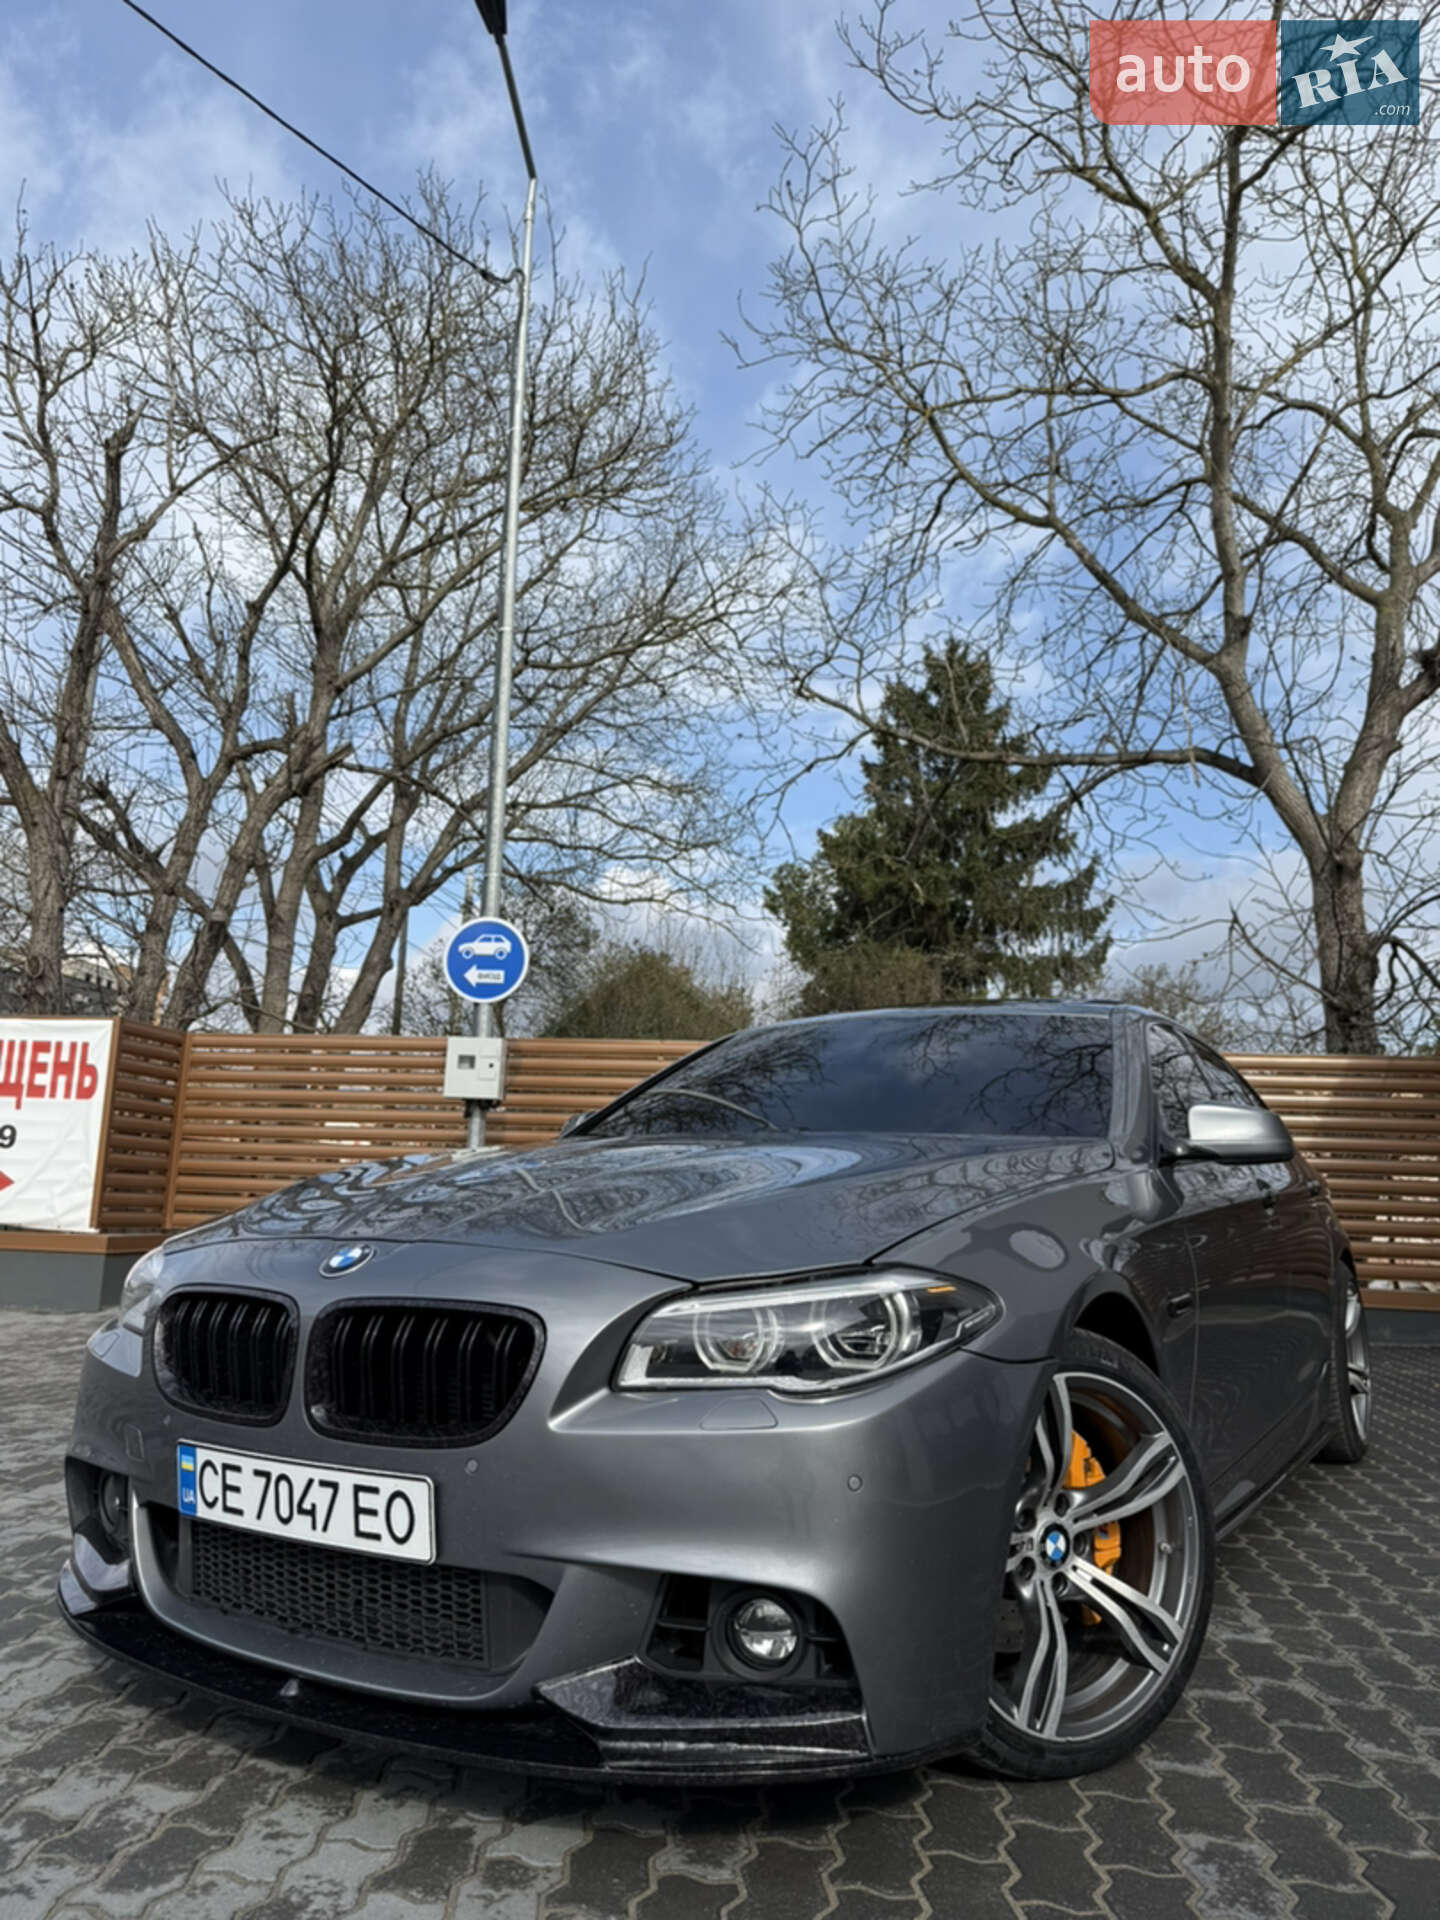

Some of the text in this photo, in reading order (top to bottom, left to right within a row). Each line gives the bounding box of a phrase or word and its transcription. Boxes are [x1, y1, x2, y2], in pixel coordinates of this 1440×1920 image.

[199, 1459, 415, 1545] CE 7047 EO
